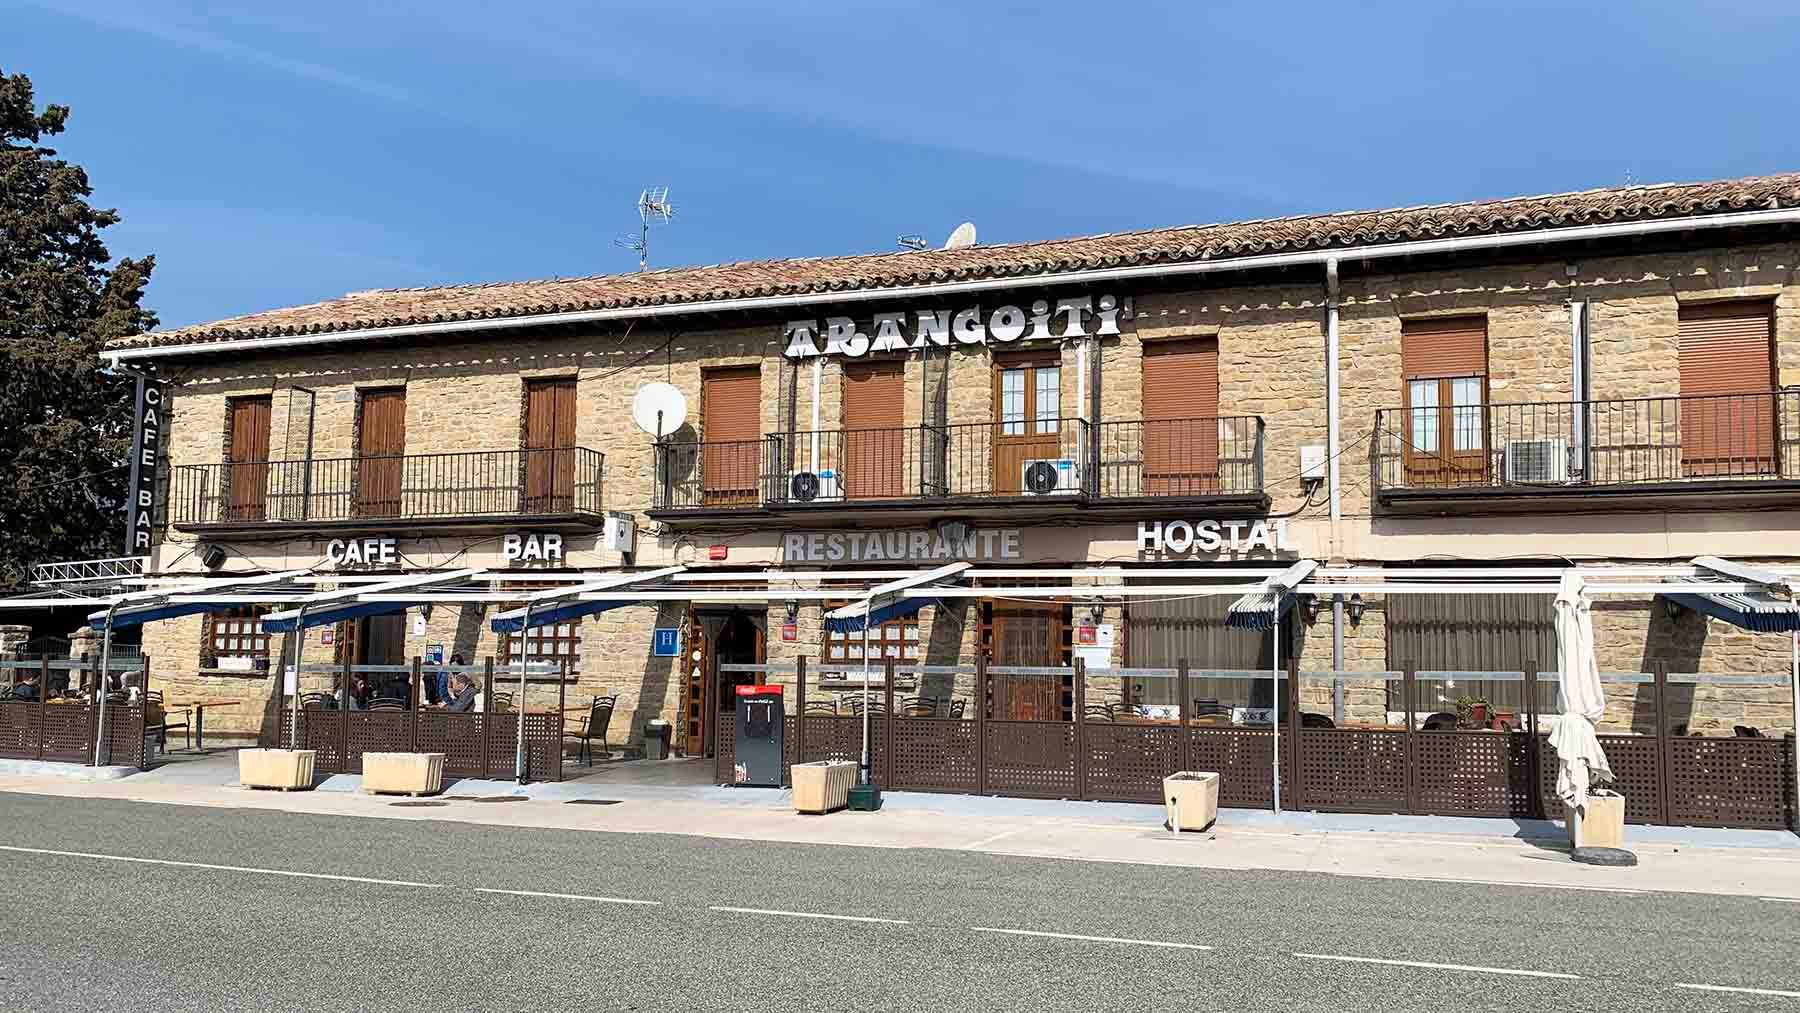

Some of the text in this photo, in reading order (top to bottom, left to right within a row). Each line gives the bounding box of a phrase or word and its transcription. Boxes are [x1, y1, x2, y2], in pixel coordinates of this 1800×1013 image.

[502, 533, 564, 562] BAR
[1136, 519, 1293, 553] HOSTAL
[326, 538, 396, 564] CAFE
